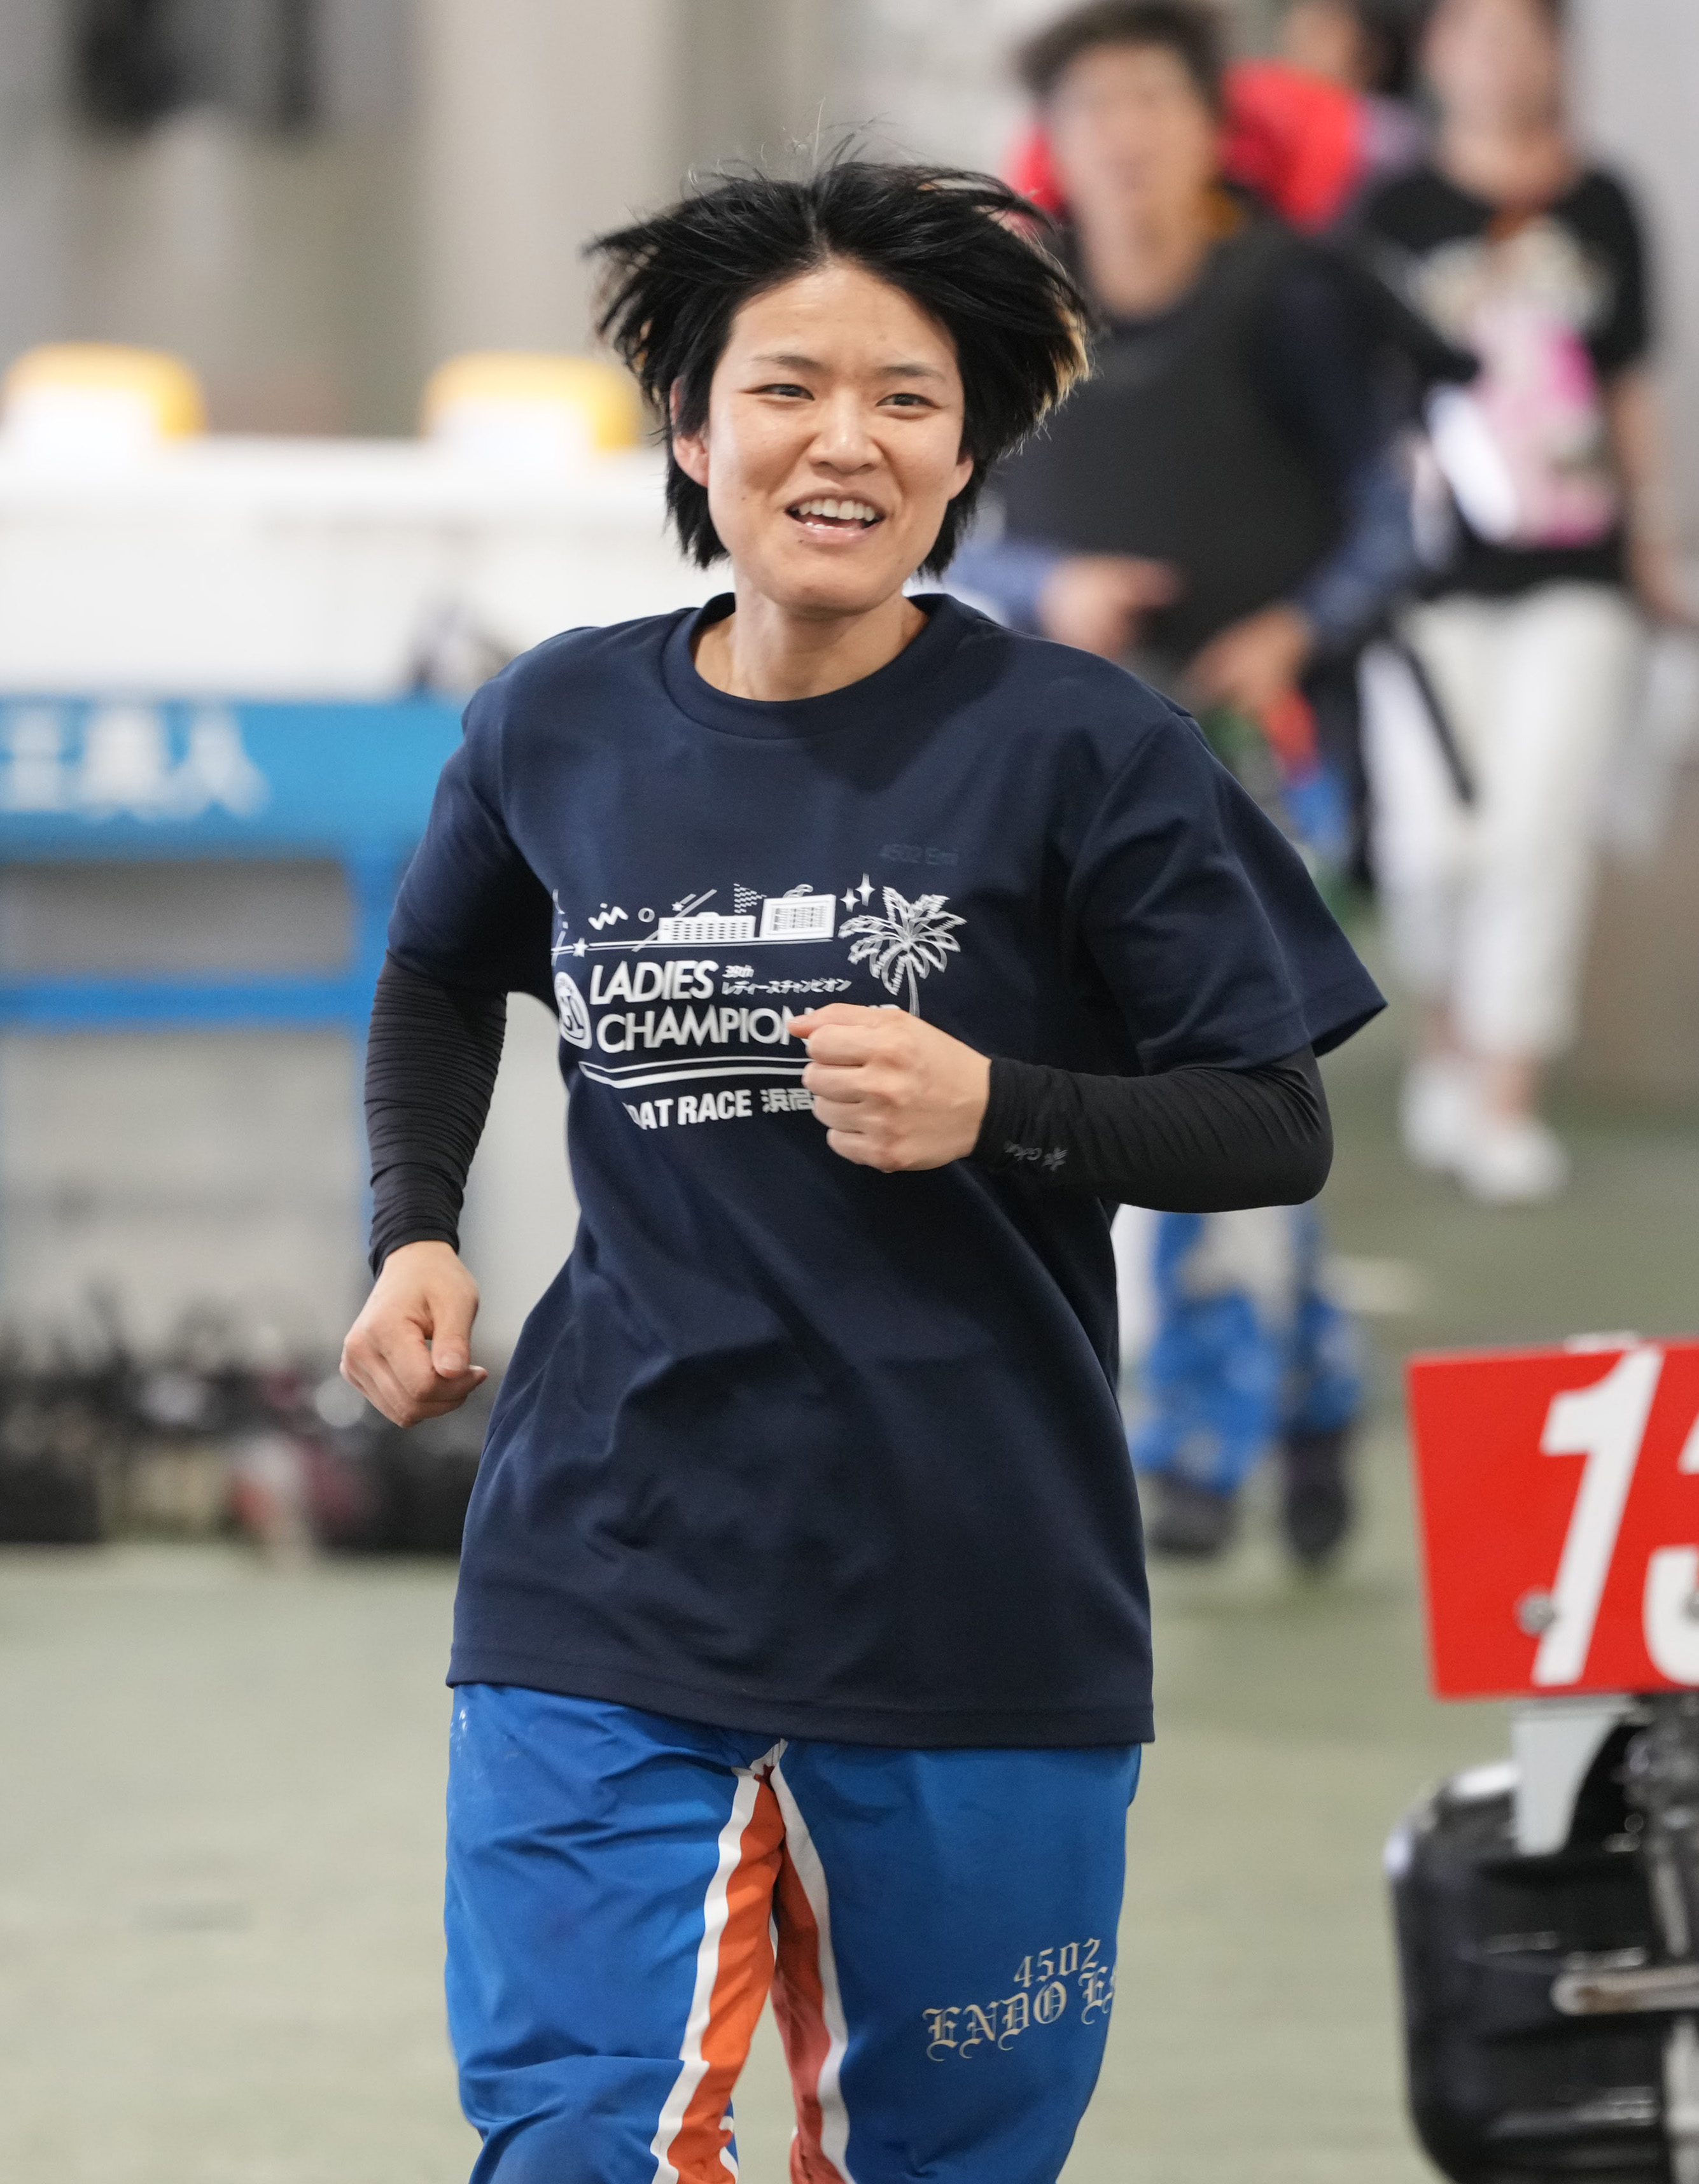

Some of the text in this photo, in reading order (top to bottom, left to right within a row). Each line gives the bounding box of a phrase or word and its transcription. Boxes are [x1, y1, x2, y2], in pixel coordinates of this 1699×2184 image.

[589, 960, 719, 1005] LADIES
[722, 977, 852, 995] レディースチャンピオン
[677, 1089, 753, 1126] RACE
[1013, 1938, 1101, 1988] 4502
[922, 1980, 1067, 2062] ENDO
